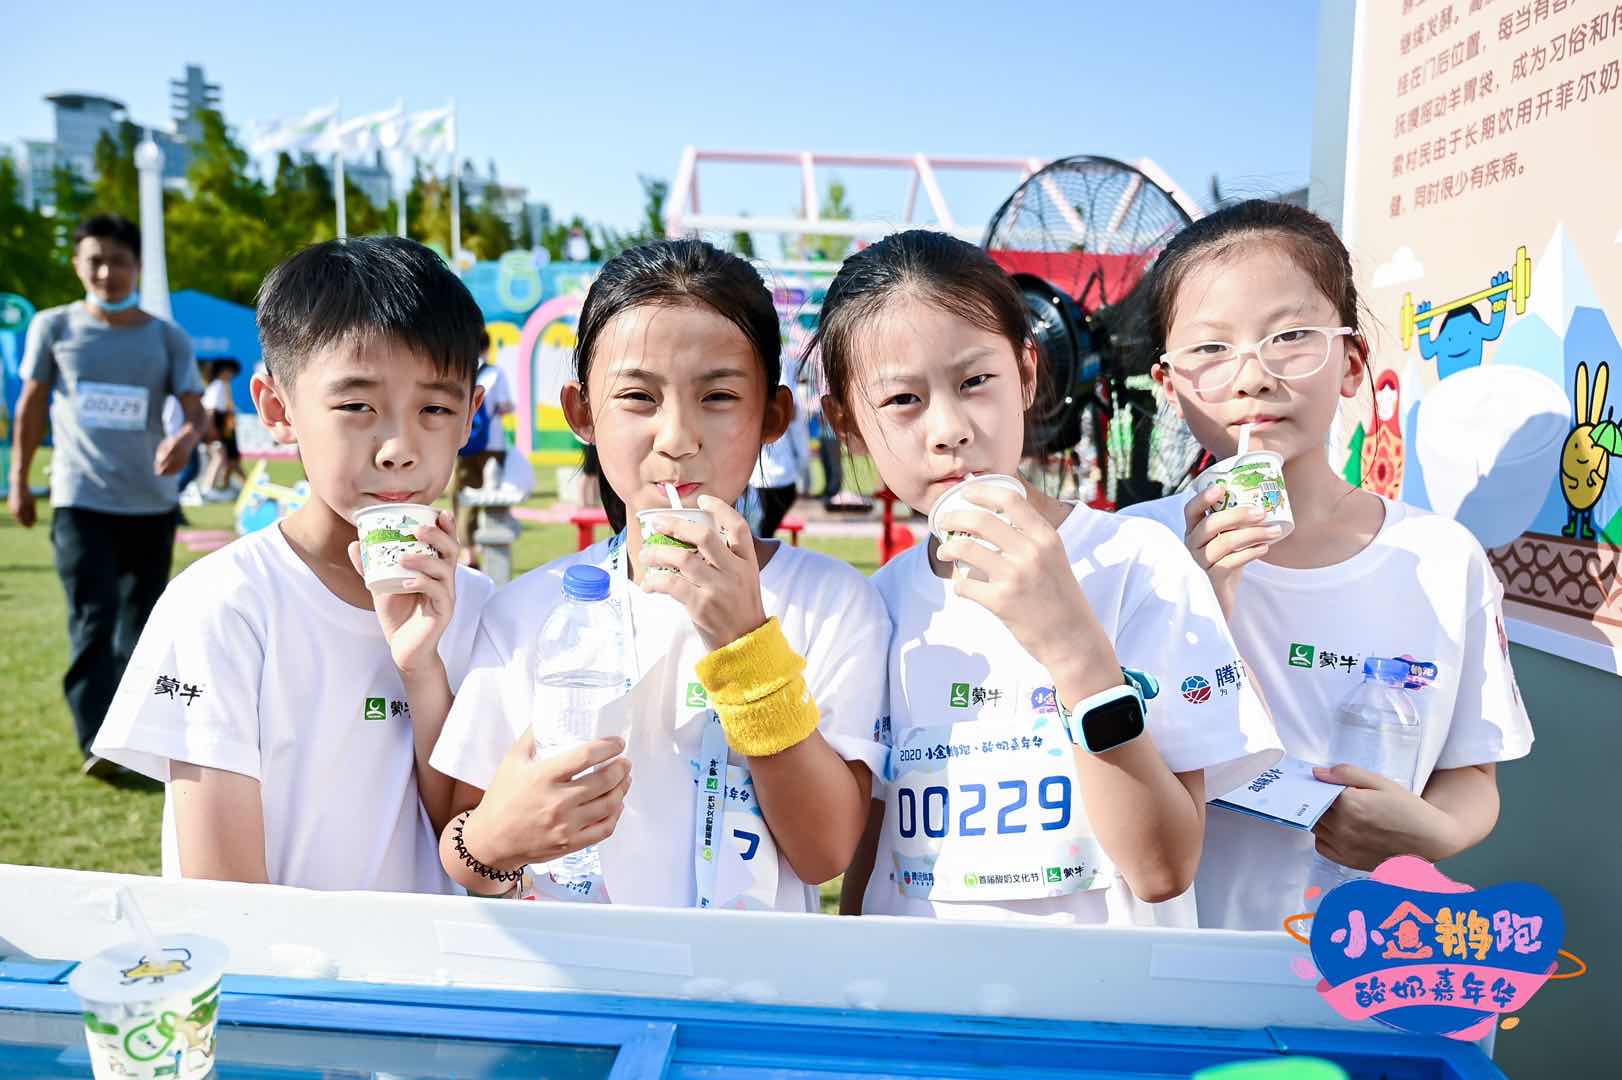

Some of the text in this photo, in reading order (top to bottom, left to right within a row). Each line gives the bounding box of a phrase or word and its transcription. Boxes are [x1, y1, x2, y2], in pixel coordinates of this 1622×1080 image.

[1319, 651, 1358, 673] 蒙牛
[154, 674, 203, 706] 蒙牛
[972, 687, 1003, 707] 蒙牛
[900, 748, 922, 761] 2020
[898, 775, 1072, 838] 00229
[1063, 865, 1085, 879] 蒙牛
